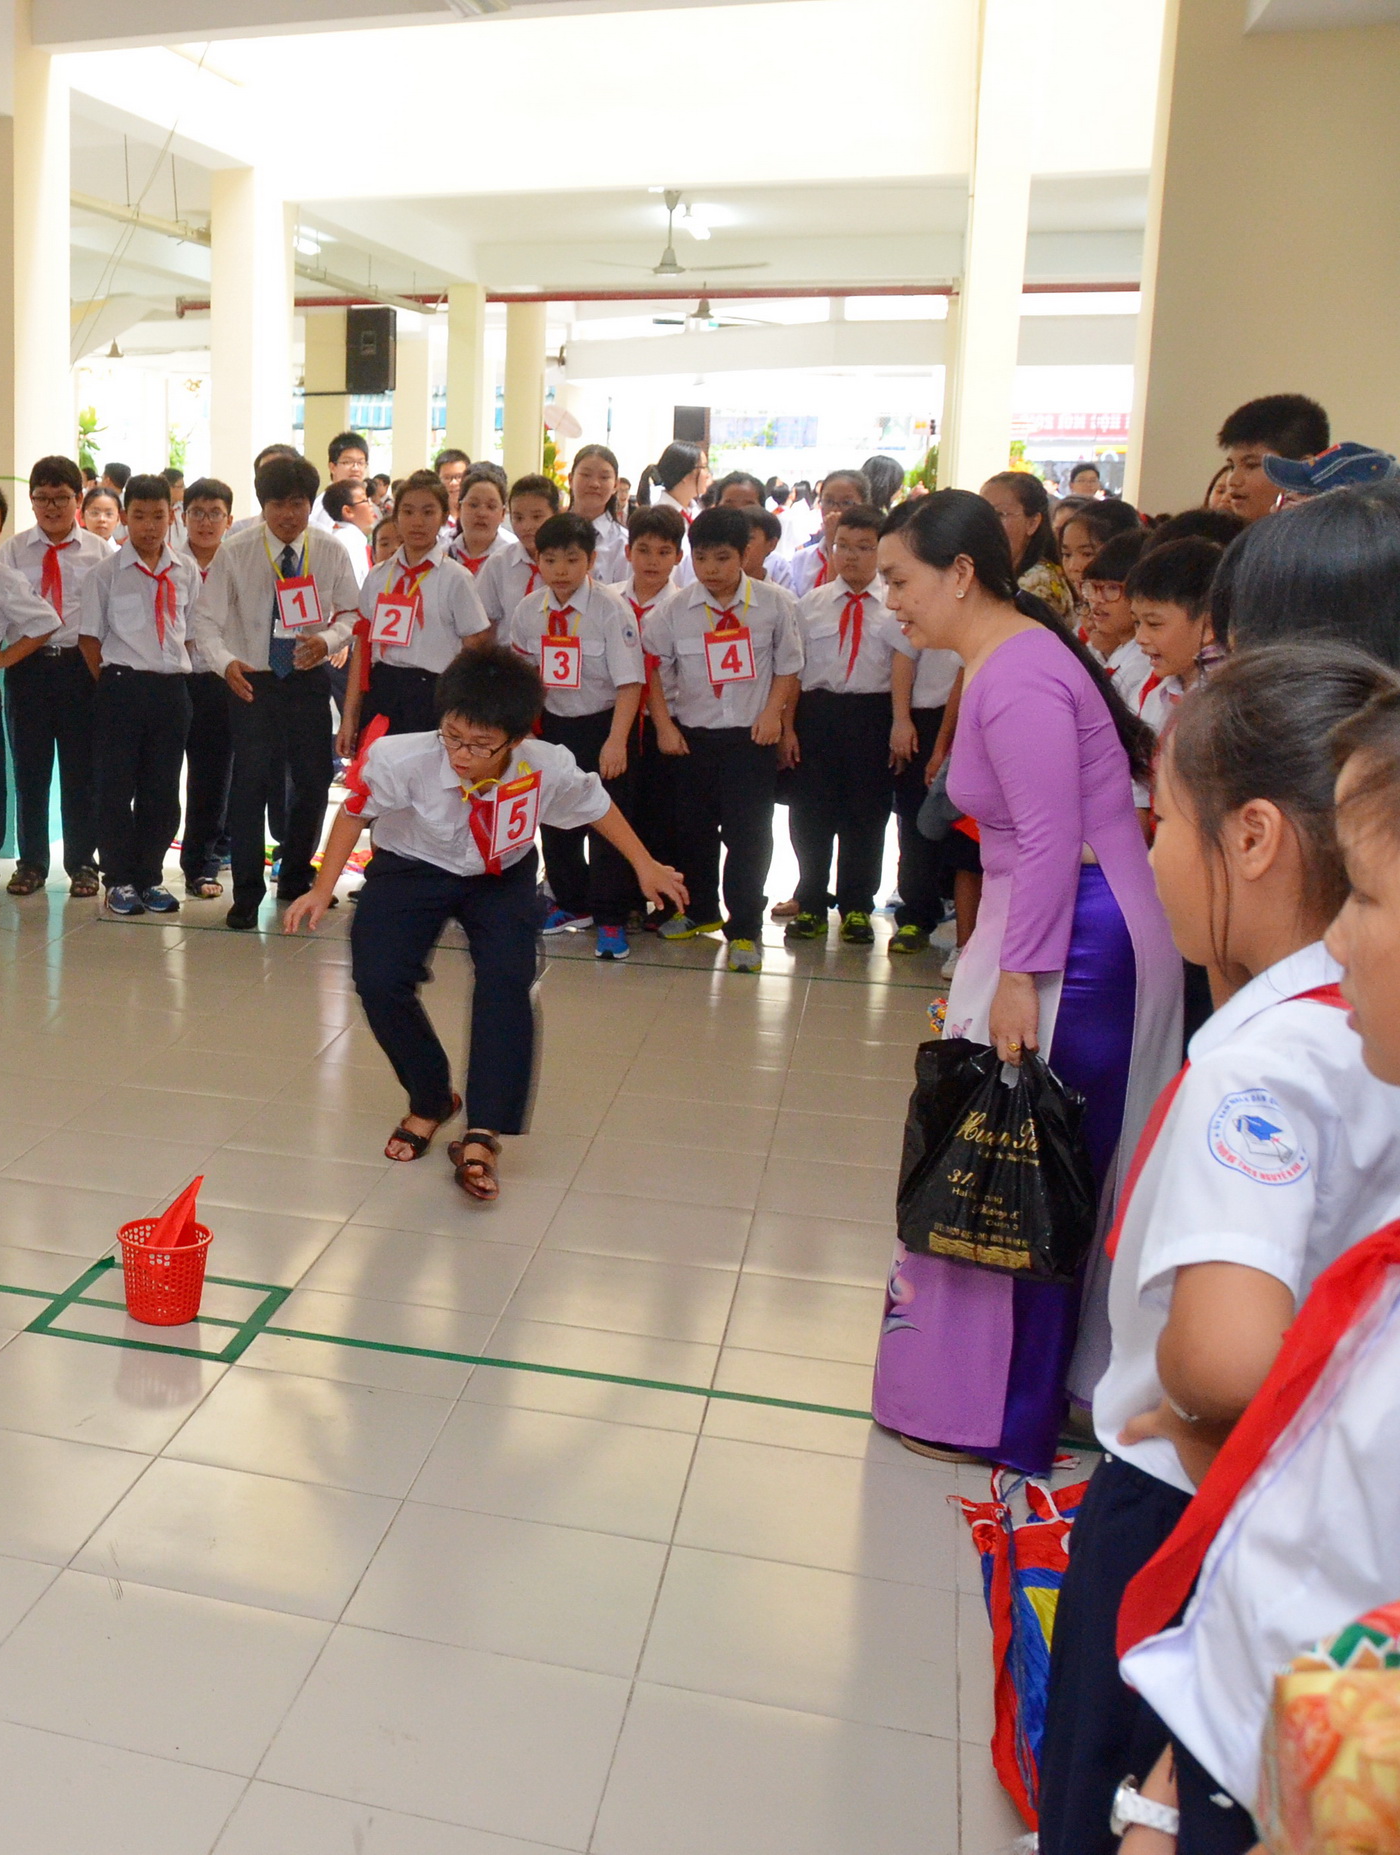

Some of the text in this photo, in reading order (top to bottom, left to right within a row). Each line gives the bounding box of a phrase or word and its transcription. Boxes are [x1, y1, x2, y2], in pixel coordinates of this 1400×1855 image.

[292, 590, 307, 619] 1
[380, 608, 401, 637] 2
[553, 651, 570, 680] 3
[720, 644, 743, 673] 4
[507, 796, 529, 840] 5
